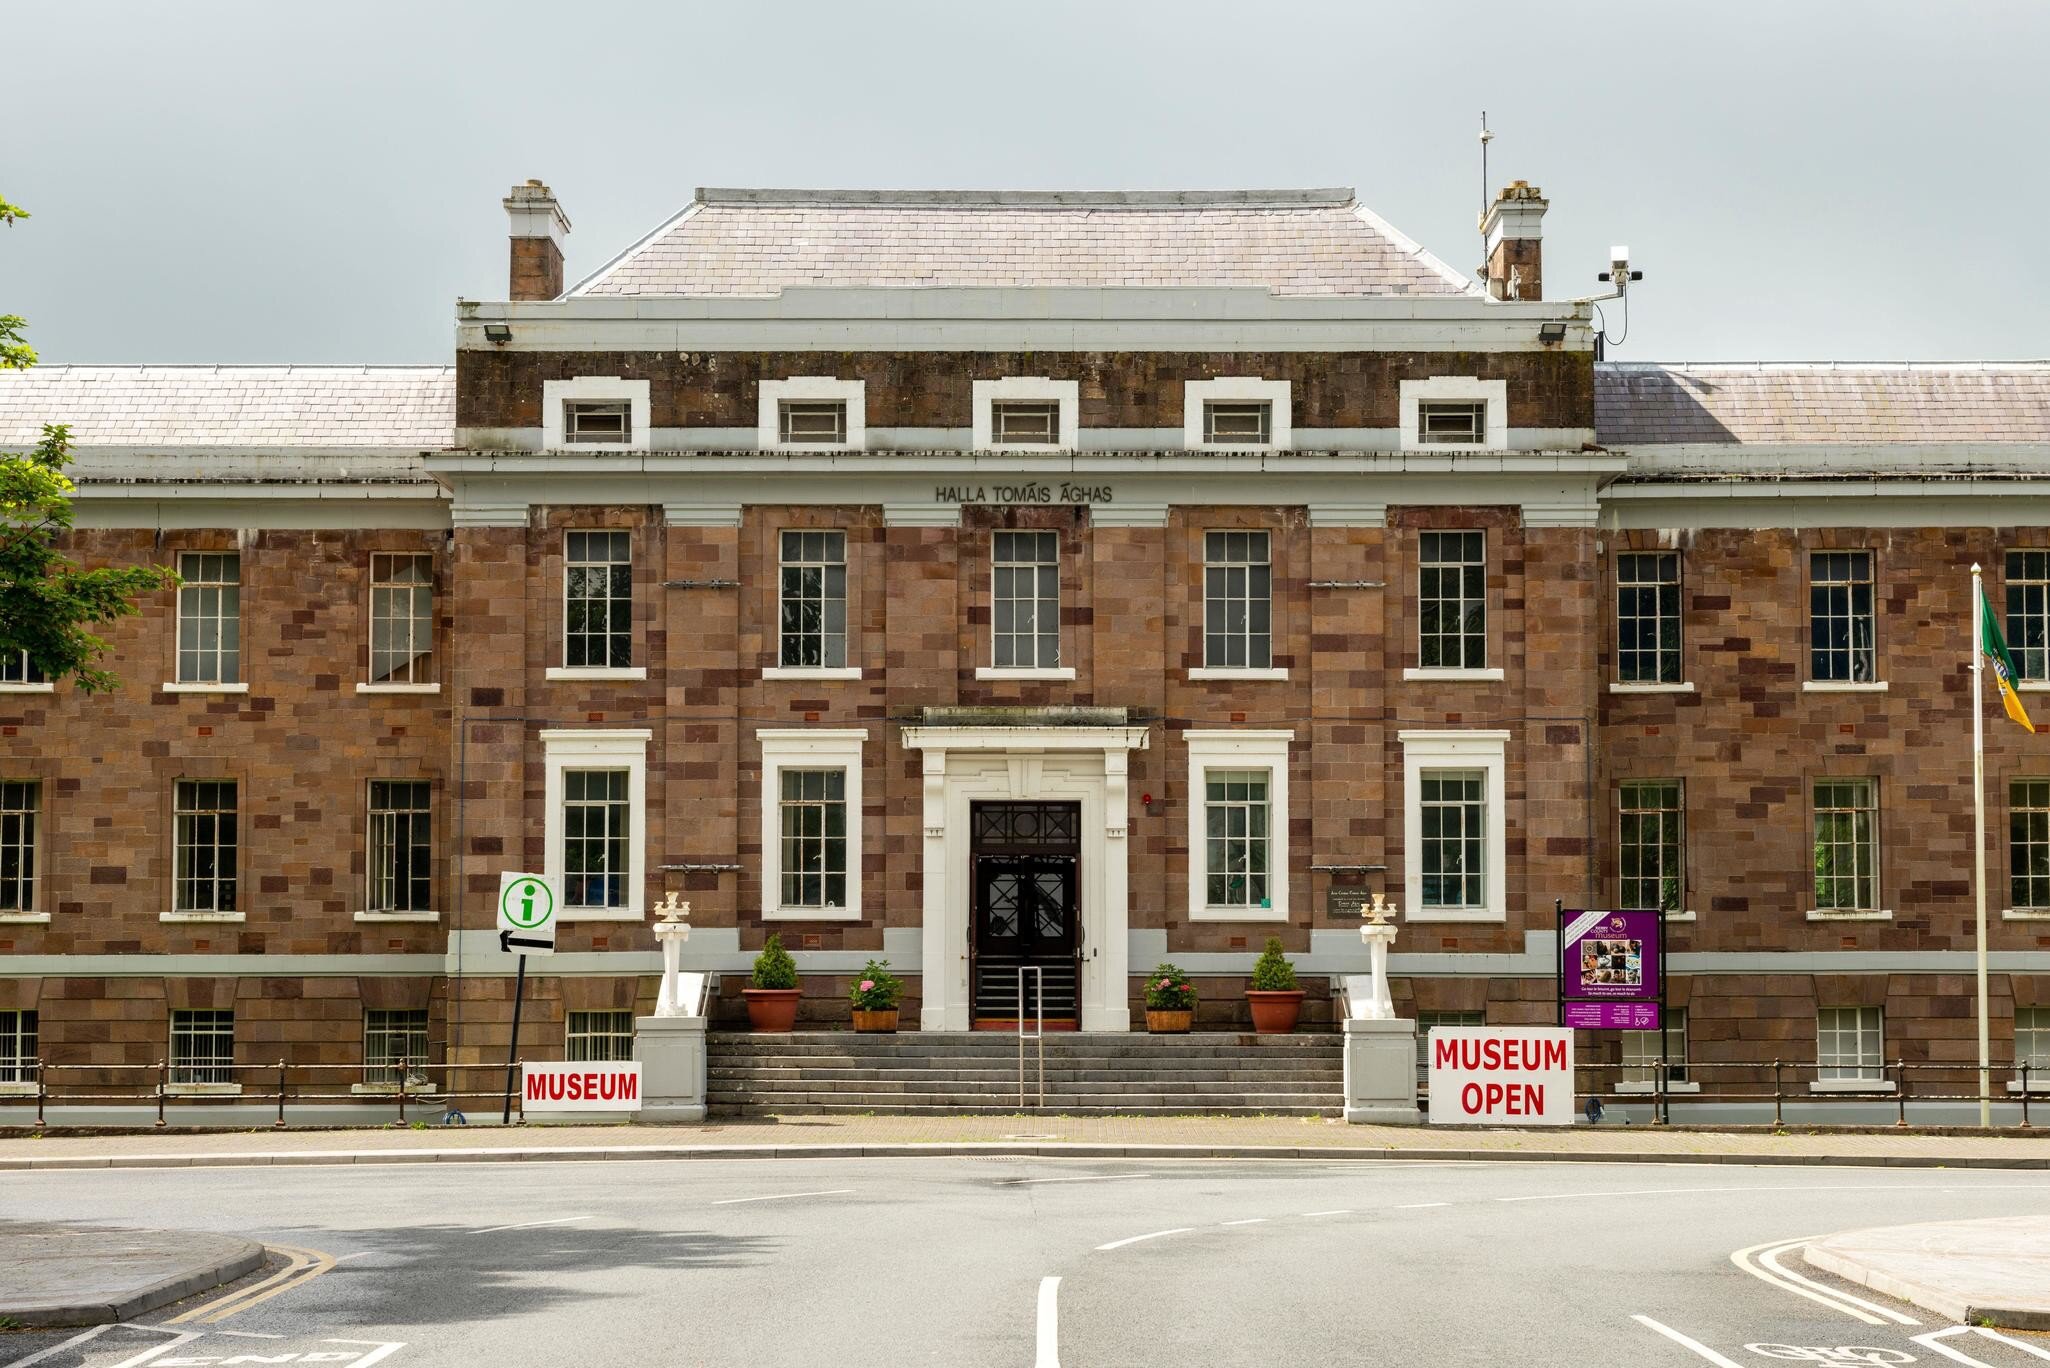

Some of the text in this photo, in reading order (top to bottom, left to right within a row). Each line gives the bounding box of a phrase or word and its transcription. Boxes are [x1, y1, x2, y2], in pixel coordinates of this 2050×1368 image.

[936, 482, 1113, 503] HALLA TOMÁIS ÁGHAS
[1436, 1039, 1567, 1071] MUSEUM
[527, 1073, 637, 1101] MUSEUM
[1461, 1082, 1544, 1115] OPEN
[147, 1352, 365, 1367] END
